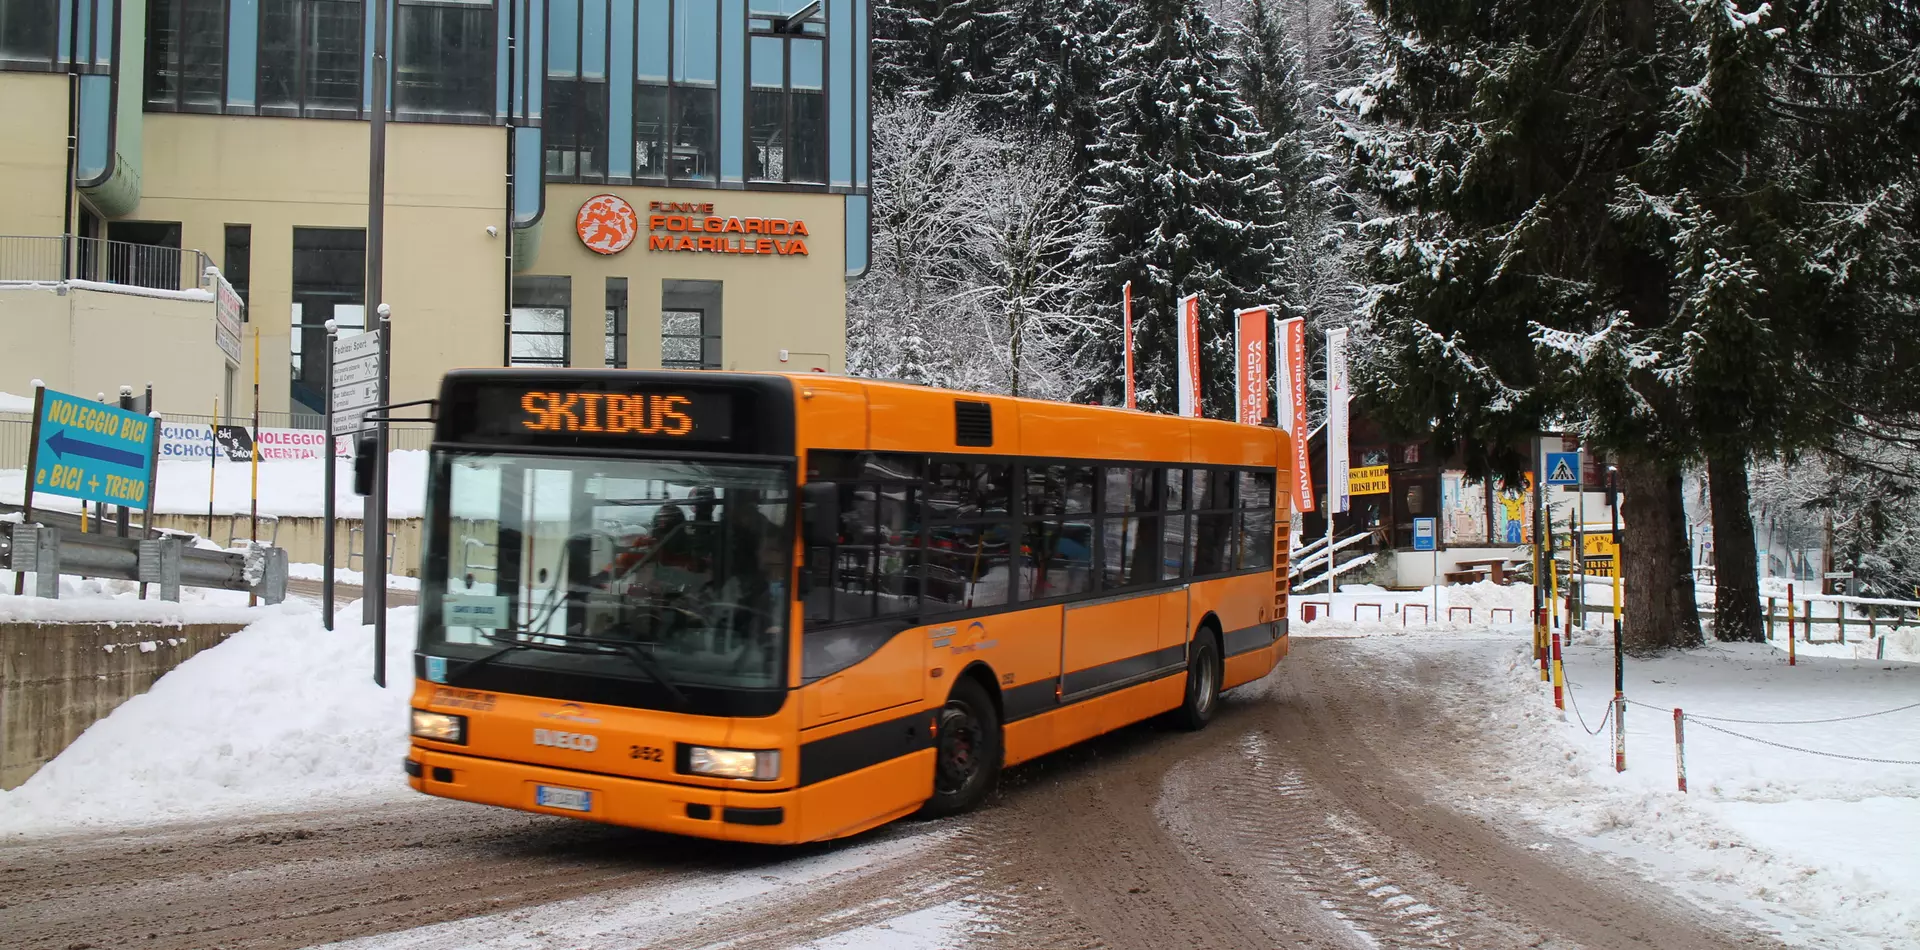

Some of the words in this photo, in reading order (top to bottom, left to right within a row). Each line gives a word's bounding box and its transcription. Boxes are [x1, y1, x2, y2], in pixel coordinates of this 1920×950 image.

[649, 201, 714, 213] FUNIVIE
[649, 215, 808, 236] FOLGARIDA
[649, 235, 808, 255] MARILLEVA
[353, 340, 367, 351] Sport
[1295, 323, 1303, 406] MARILLEVA
[1248, 340, 1256, 426] OLGARIDA
[48, 400, 119, 436] NOLEGGIO
[120, 417, 148, 443] BICI
[521, 391, 692, 435] SKIBUS
[1296, 411, 1303, 421] A
[256, 432, 325, 445] NOLEGGIO
[163, 443, 224, 457] SCHOOL
[263, 447, 317, 460] RENTAL
[1297, 427, 1312, 509] BENVENUTI
[1349, 470, 1368, 480] OSCAR
[36, 468, 46, 485] e
[49, 464, 84, 491] BICI
[88, 474, 100, 493] +
[104, 474, 145, 502] TRENO
[1351, 481, 1370, 492] IRISH
[1372, 480, 1387, 491] PUB
[1600, 535, 1614, 545] WILD
[533, 728, 599, 753] IVECO
[628, 744, 664, 763] 352
